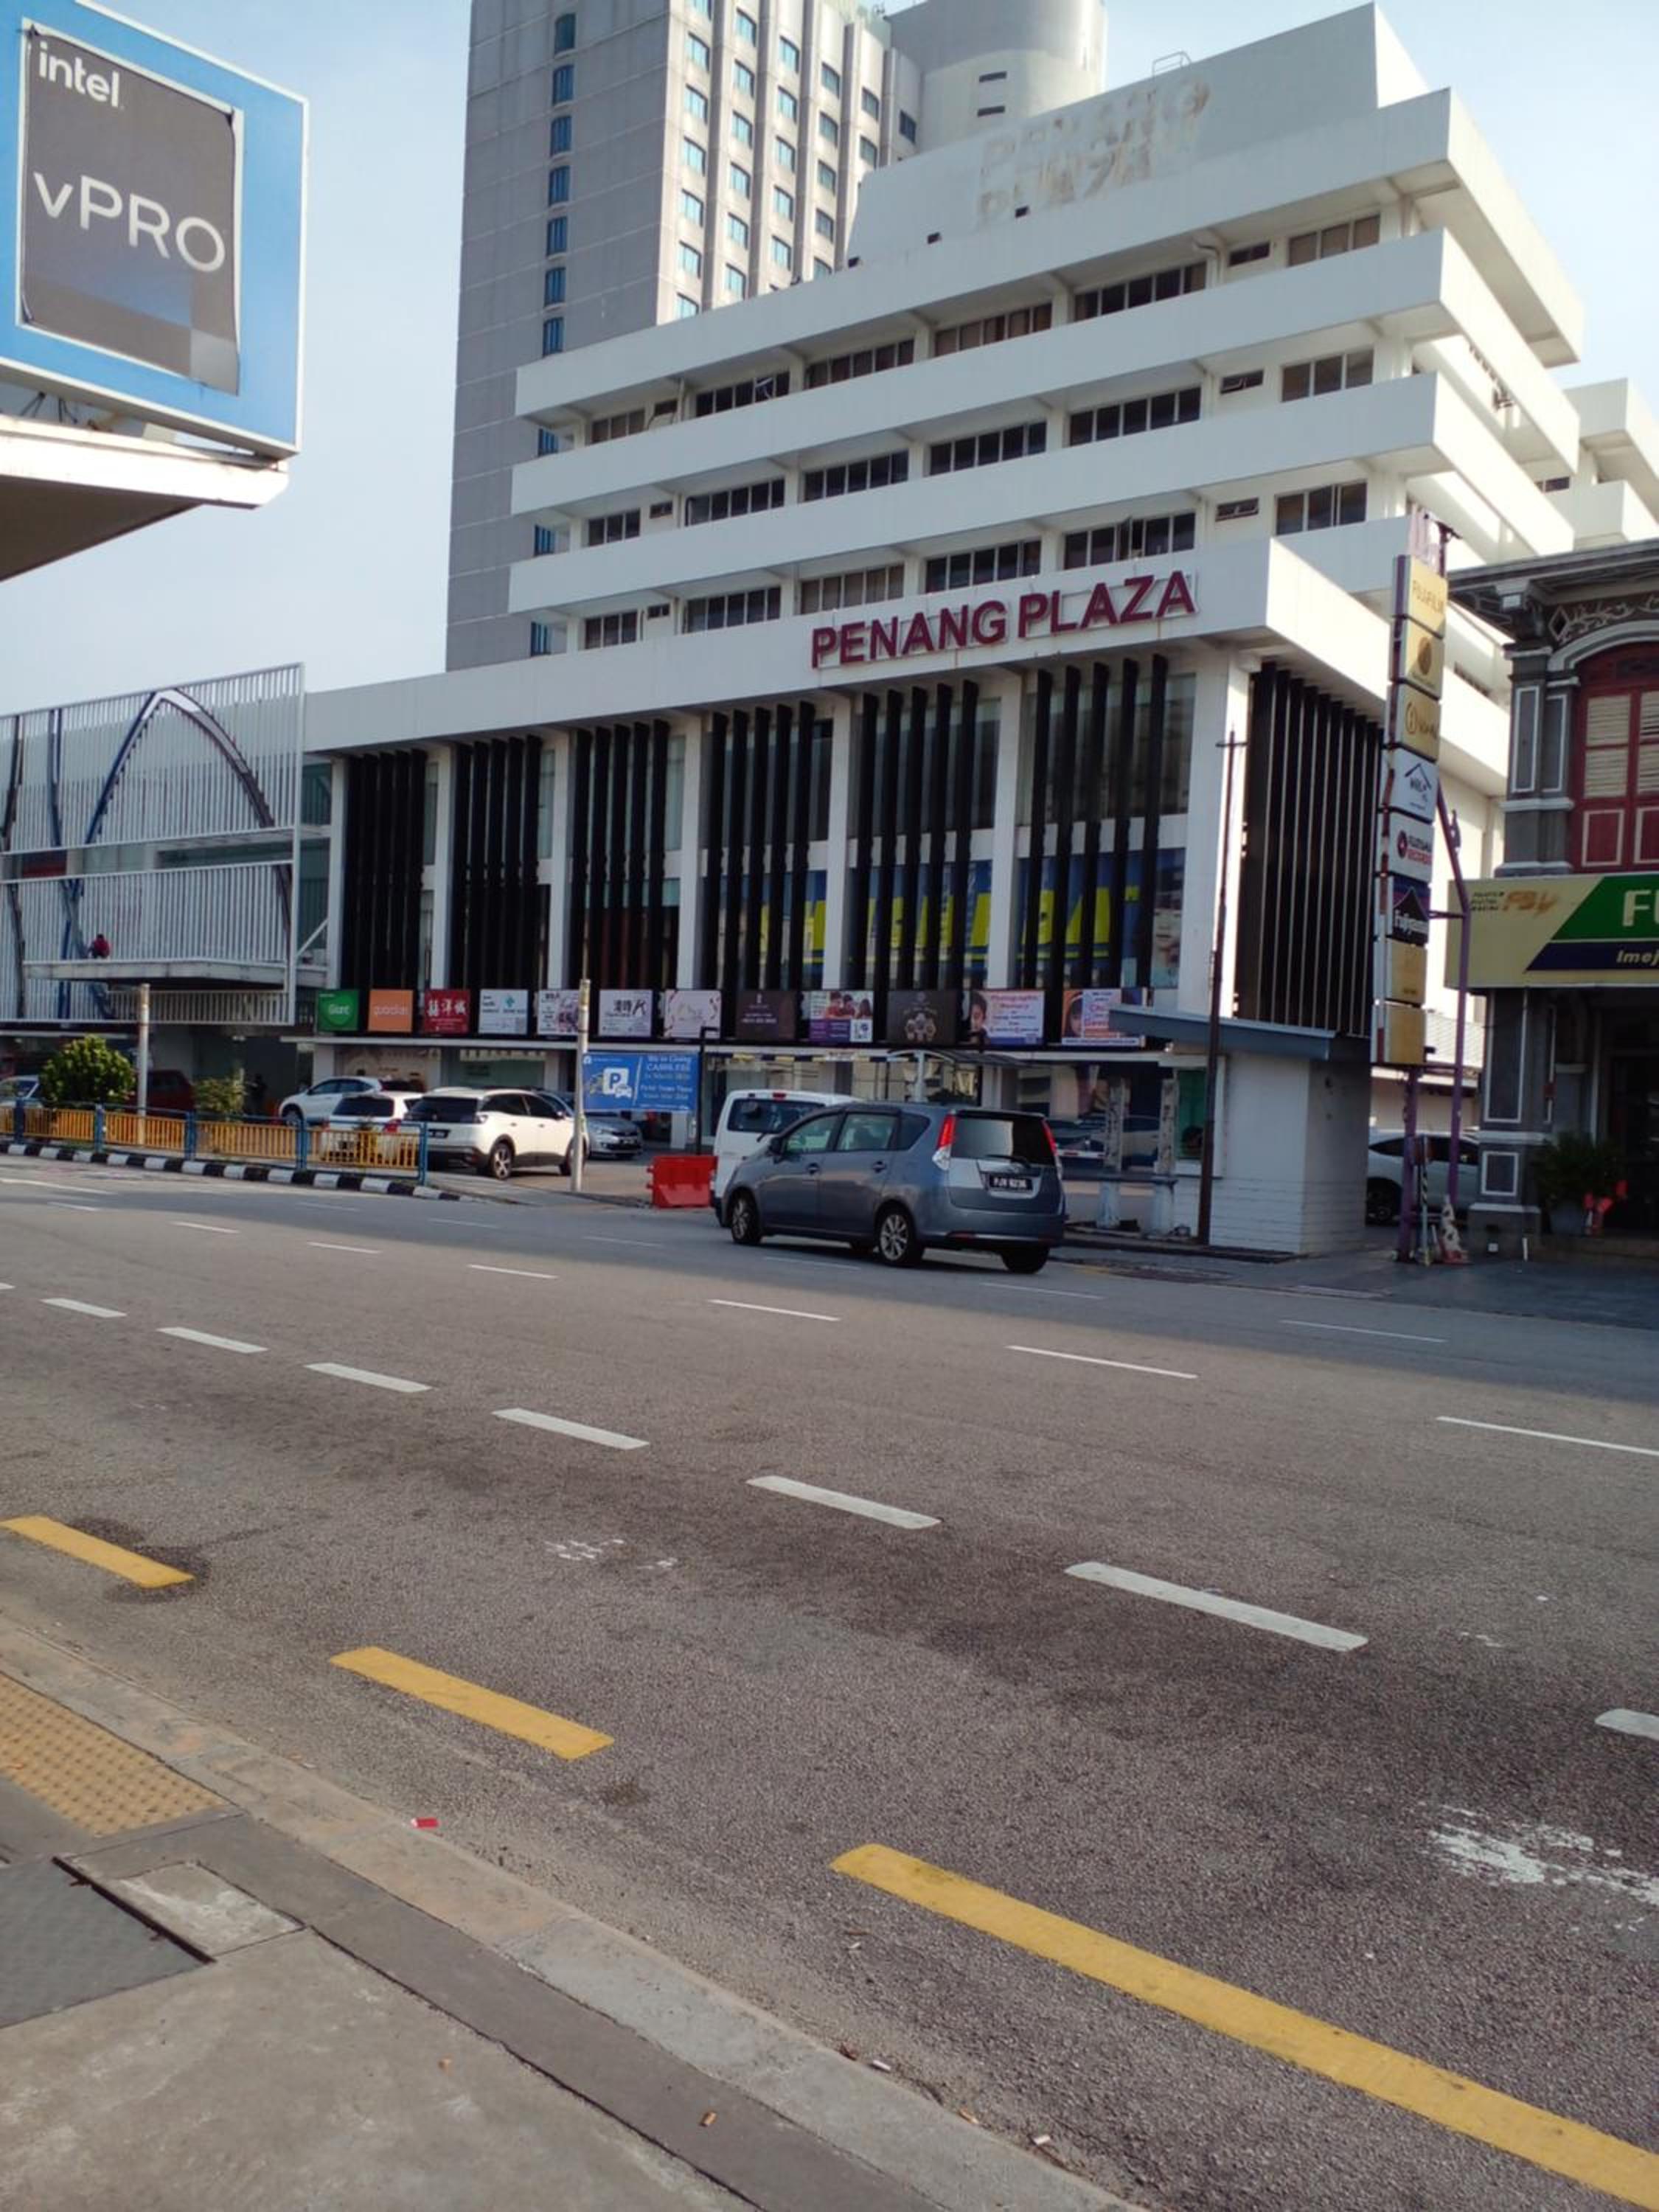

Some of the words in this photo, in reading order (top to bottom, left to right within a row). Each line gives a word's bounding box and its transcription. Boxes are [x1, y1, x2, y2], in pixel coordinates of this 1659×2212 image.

[39, 42, 119, 108] intel
[33, 171, 226, 272] vPRO
[813, 600, 1006, 668] PENANG
[1018, 570, 1197, 639] PLAZA
